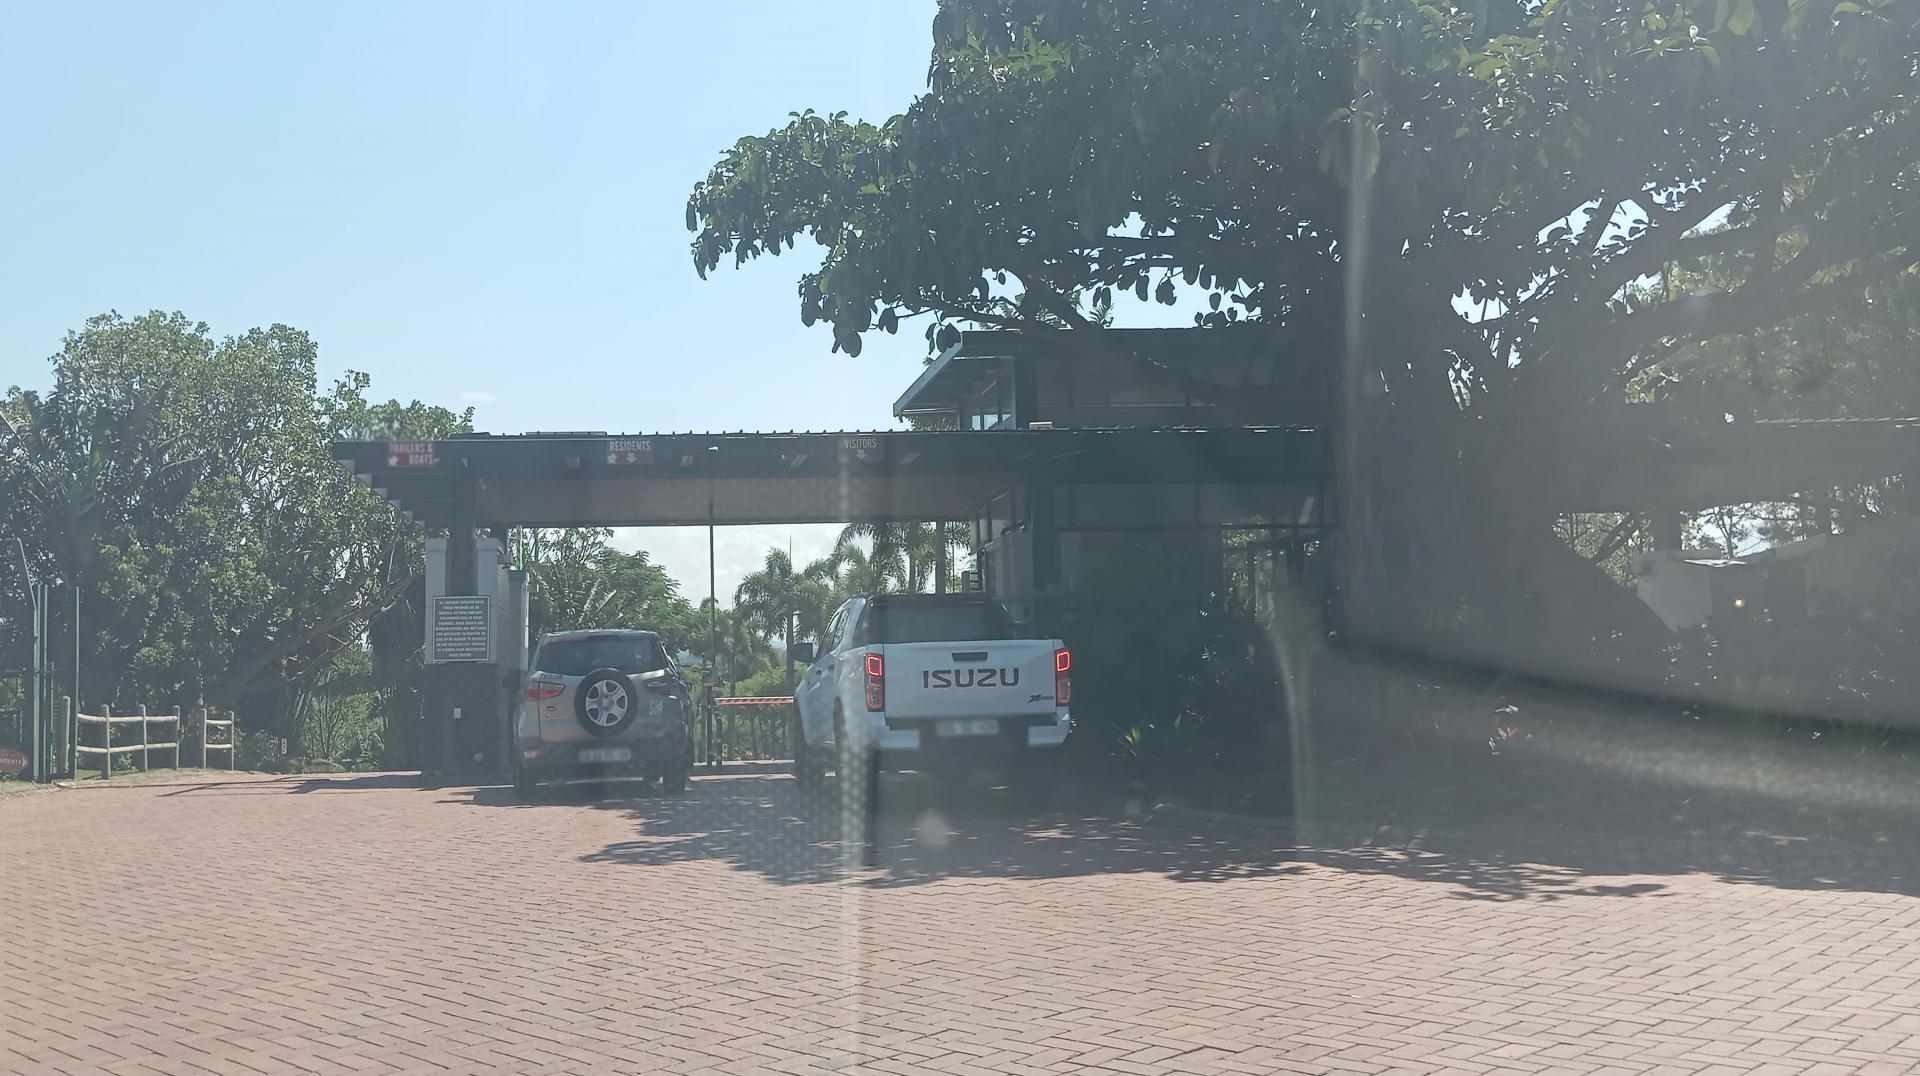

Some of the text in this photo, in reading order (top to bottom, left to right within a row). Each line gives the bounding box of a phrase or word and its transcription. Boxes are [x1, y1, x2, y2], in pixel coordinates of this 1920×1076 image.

[609, 440, 651, 452] RESIDENTS
[844, 438, 877, 449] VISITORS
[408, 453, 434, 465] BOATS
[922, 667, 1020, 689] ISUZU
